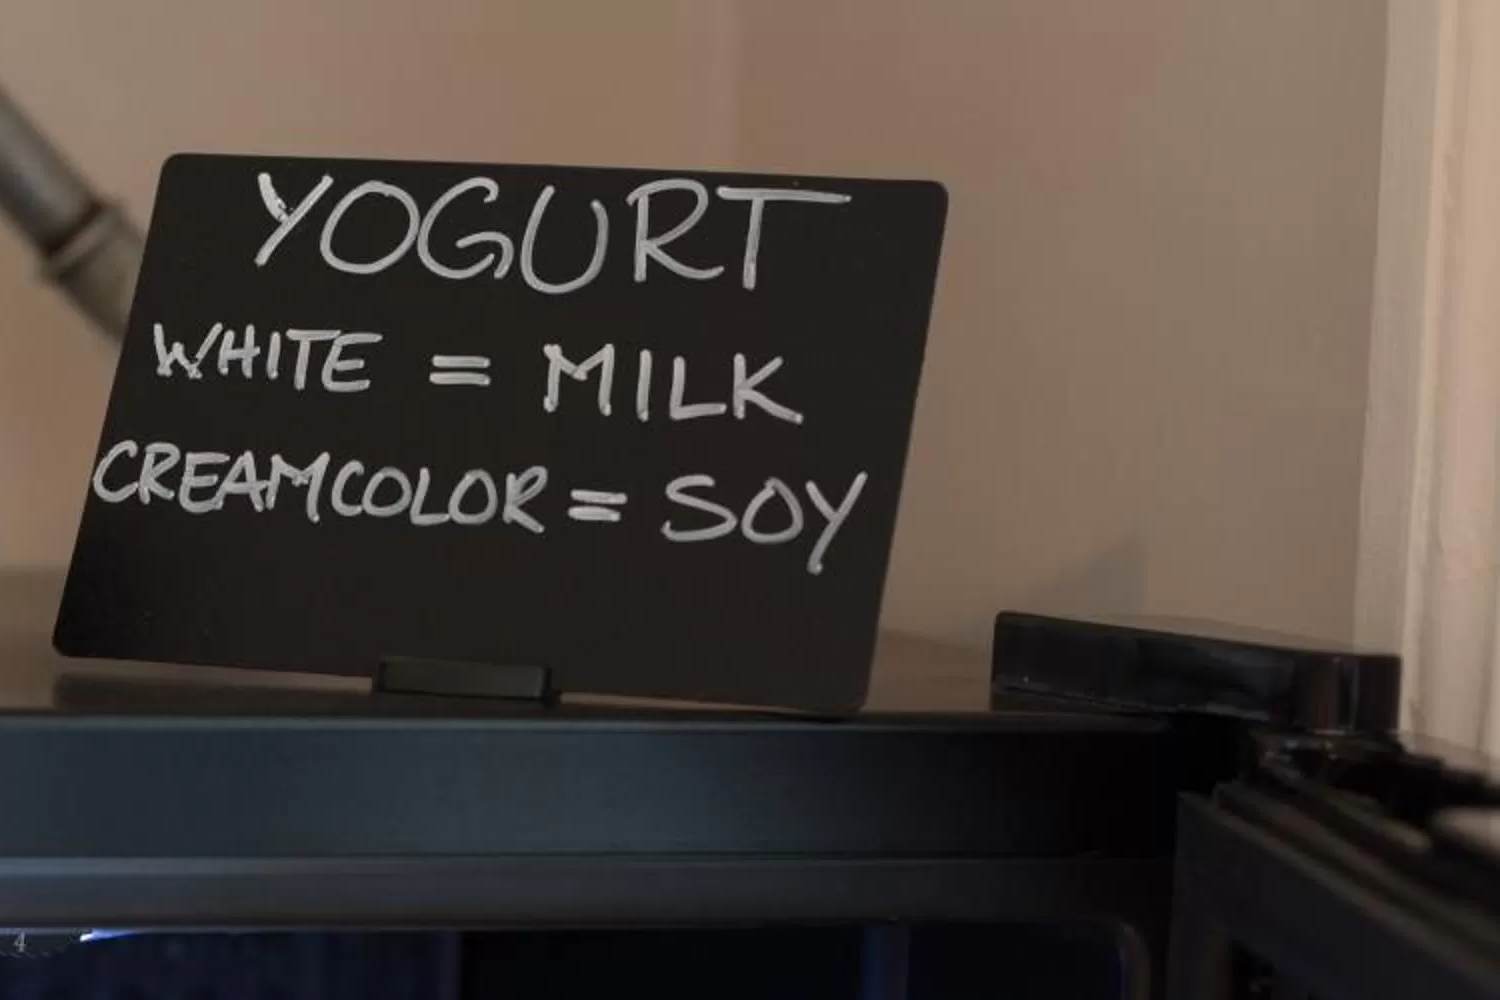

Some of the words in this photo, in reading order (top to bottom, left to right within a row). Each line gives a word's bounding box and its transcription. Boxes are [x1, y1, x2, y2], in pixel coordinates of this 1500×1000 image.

[254, 170, 852, 294] YOGURT
[153, 321, 383, 393] WHITE
[542, 343, 804, 425] MILK
[661, 471, 869, 575] SOY
